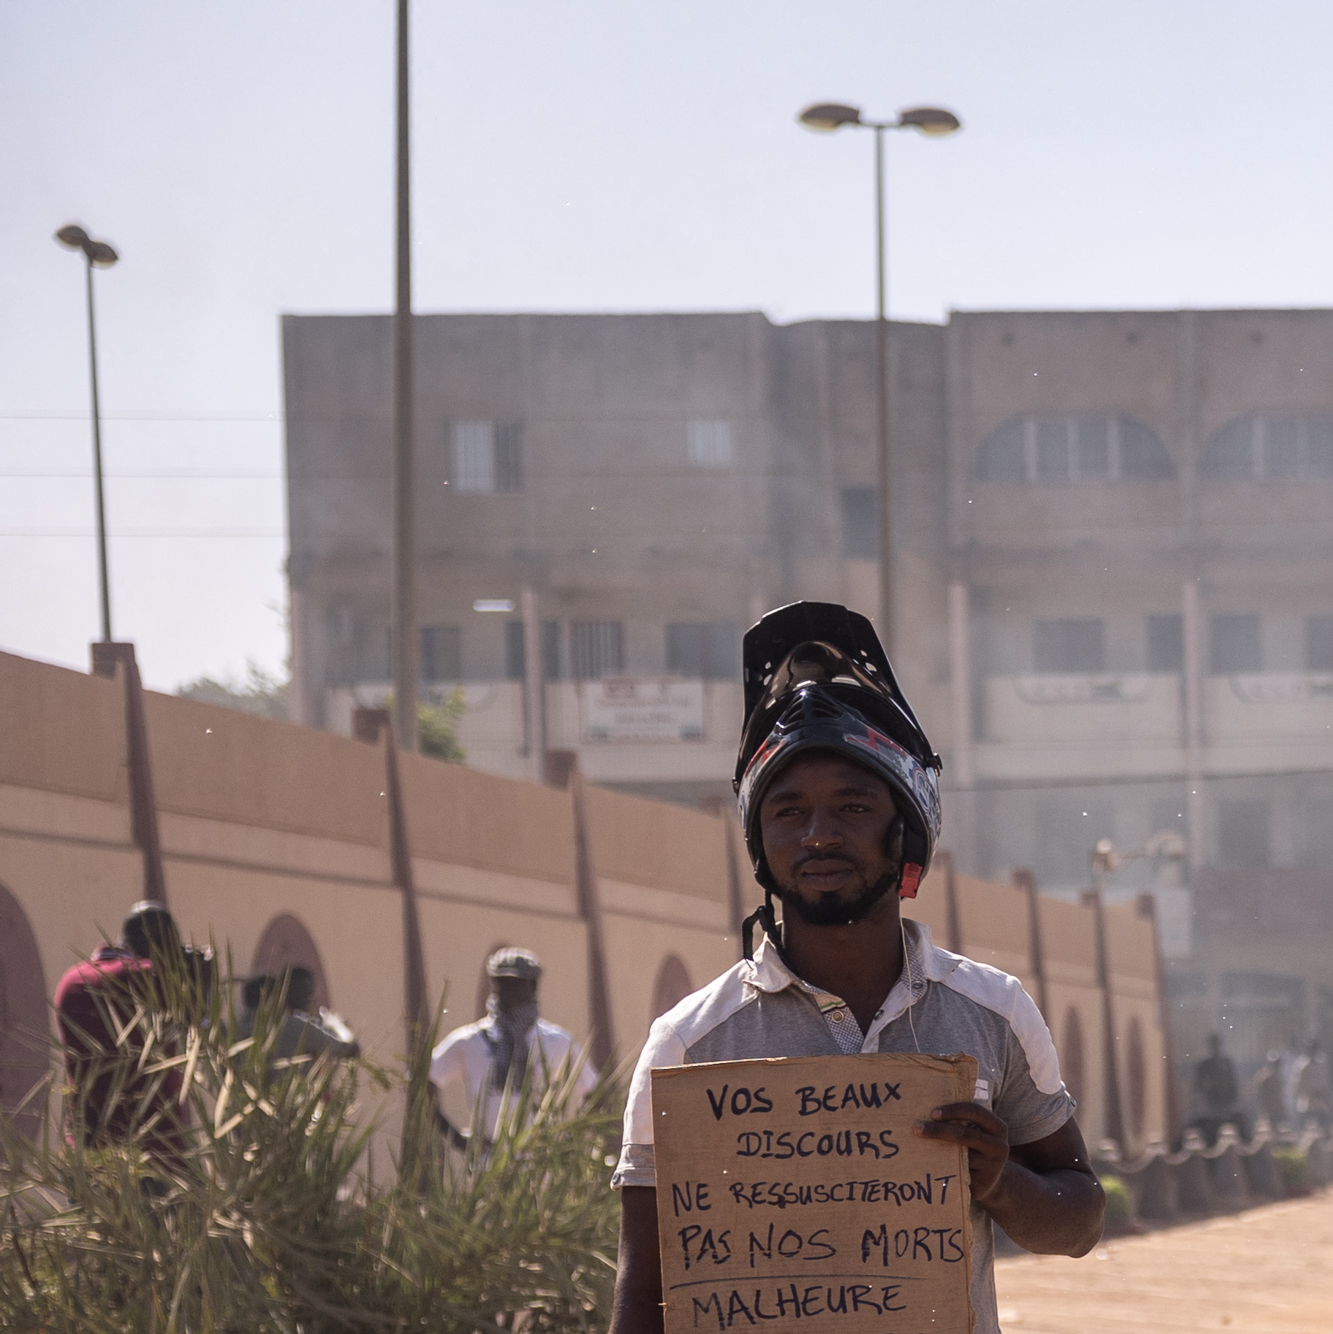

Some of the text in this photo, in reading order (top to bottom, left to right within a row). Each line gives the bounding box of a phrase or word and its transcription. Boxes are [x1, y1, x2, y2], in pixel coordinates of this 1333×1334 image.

[706, 1082, 902, 1121] VOS BEAUX
[736, 1129, 900, 1159] DISCOURS
[672, 1173, 957, 1217] NE RESSUSCITERONT
[677, 1222, 965, 1270] PAS NOS MORTS
[692, 1283, 907, 1331] MALHEURE
